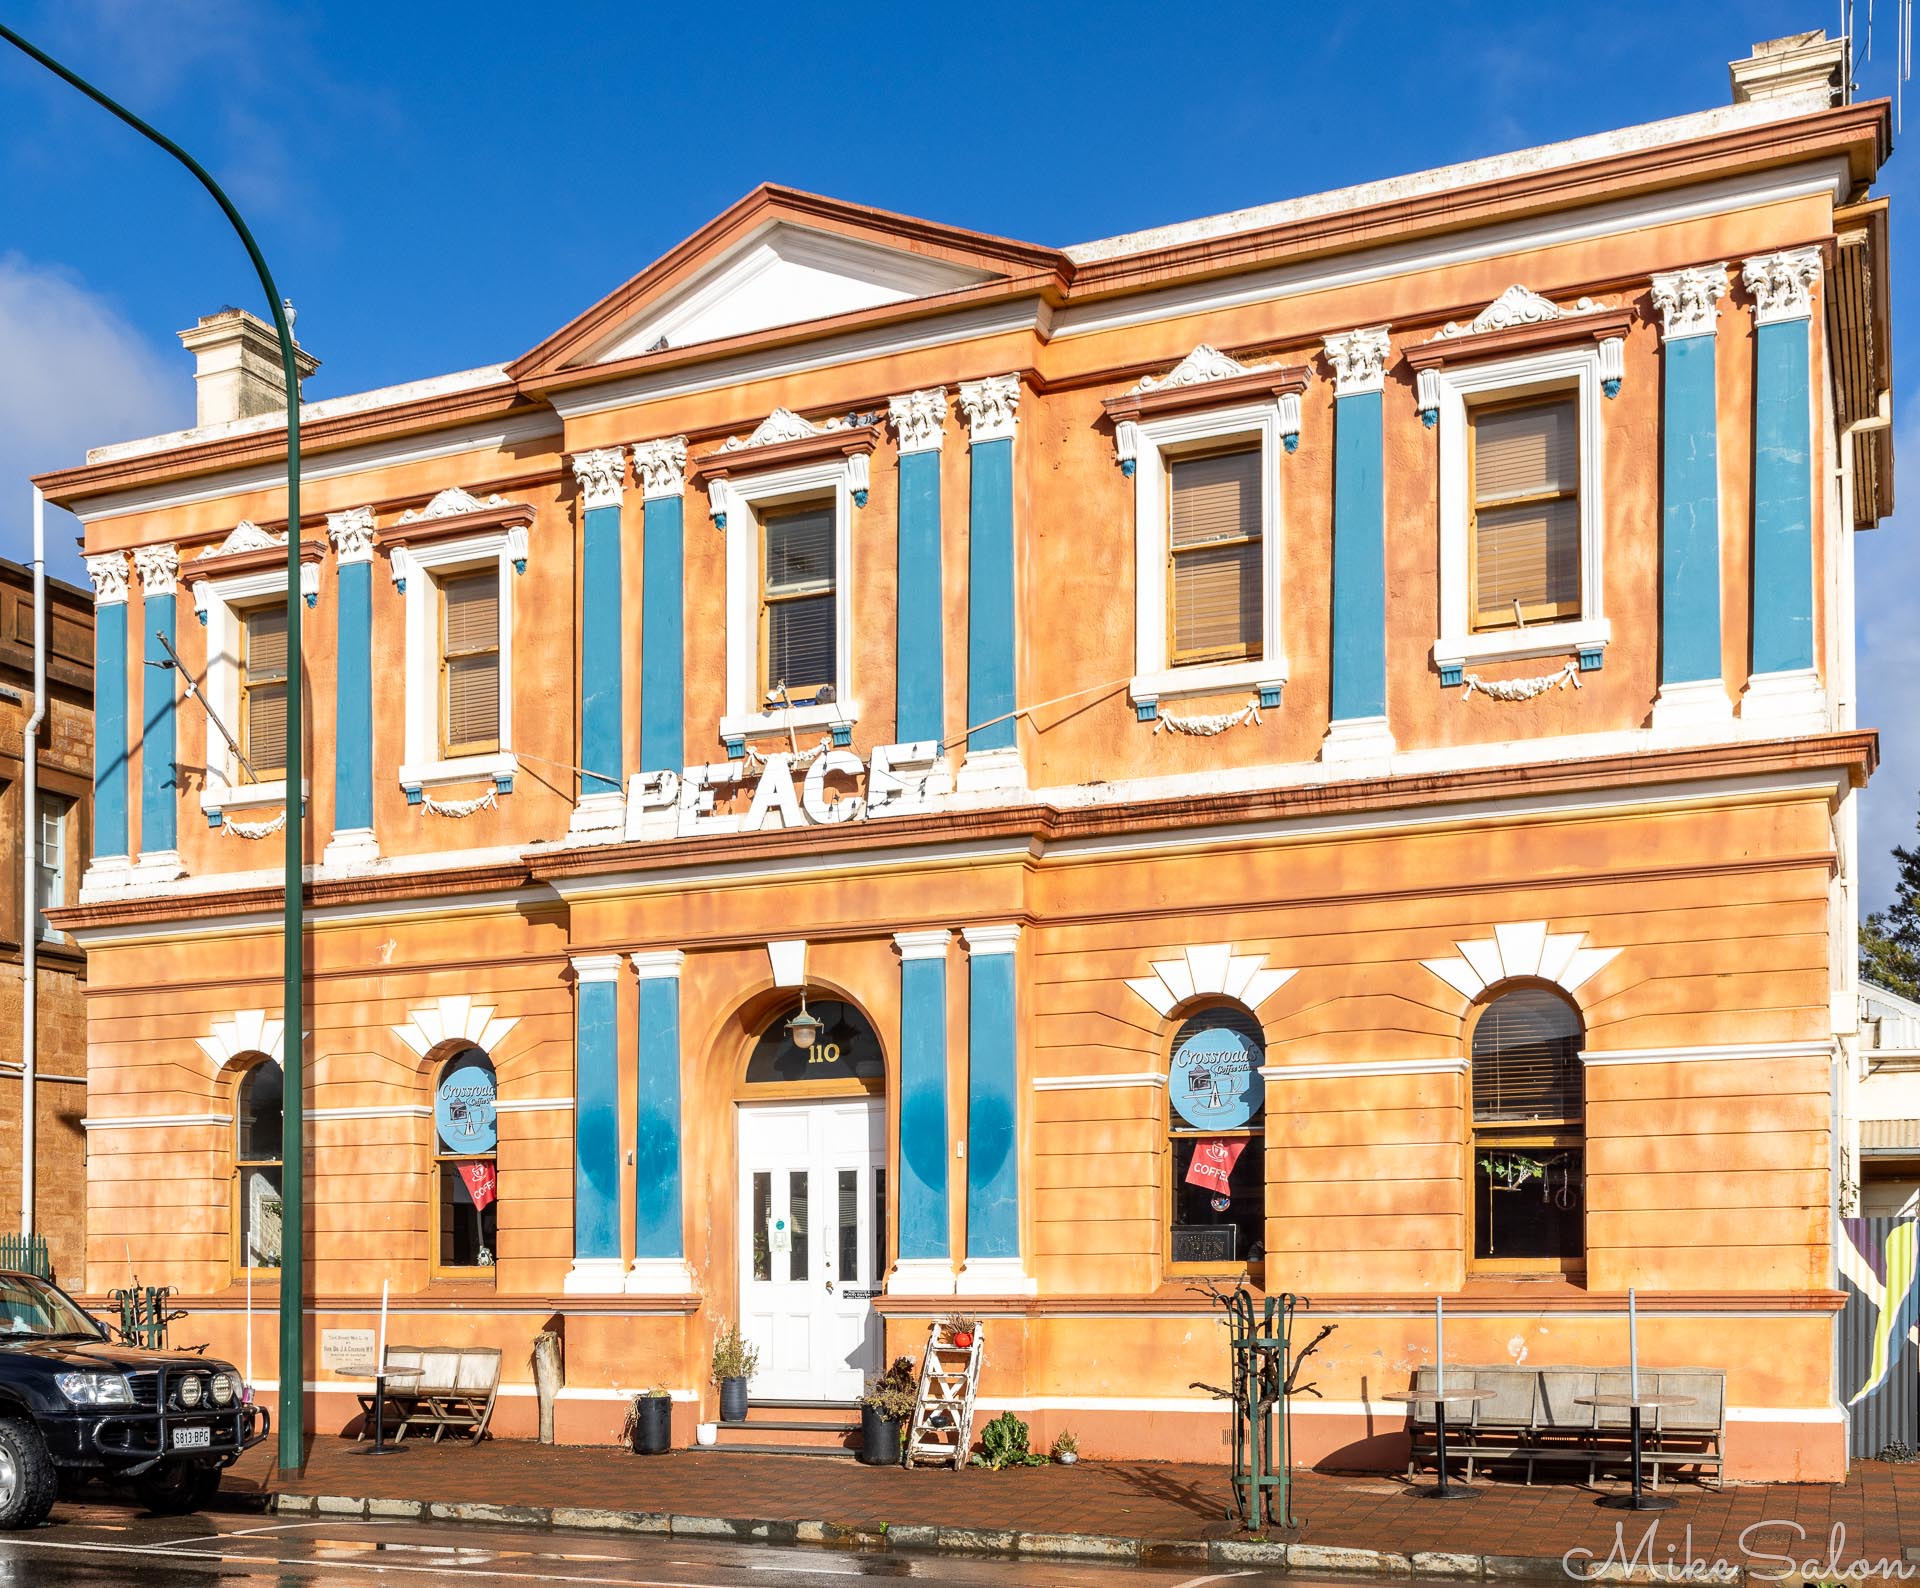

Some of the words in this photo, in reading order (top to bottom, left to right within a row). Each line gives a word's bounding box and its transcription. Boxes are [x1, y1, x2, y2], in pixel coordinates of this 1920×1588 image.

[623, 740, 938, 842] PEACE
[808, 1043, 841, 1064] 110
[1216, 1063, 1238, 1075] Coffee
